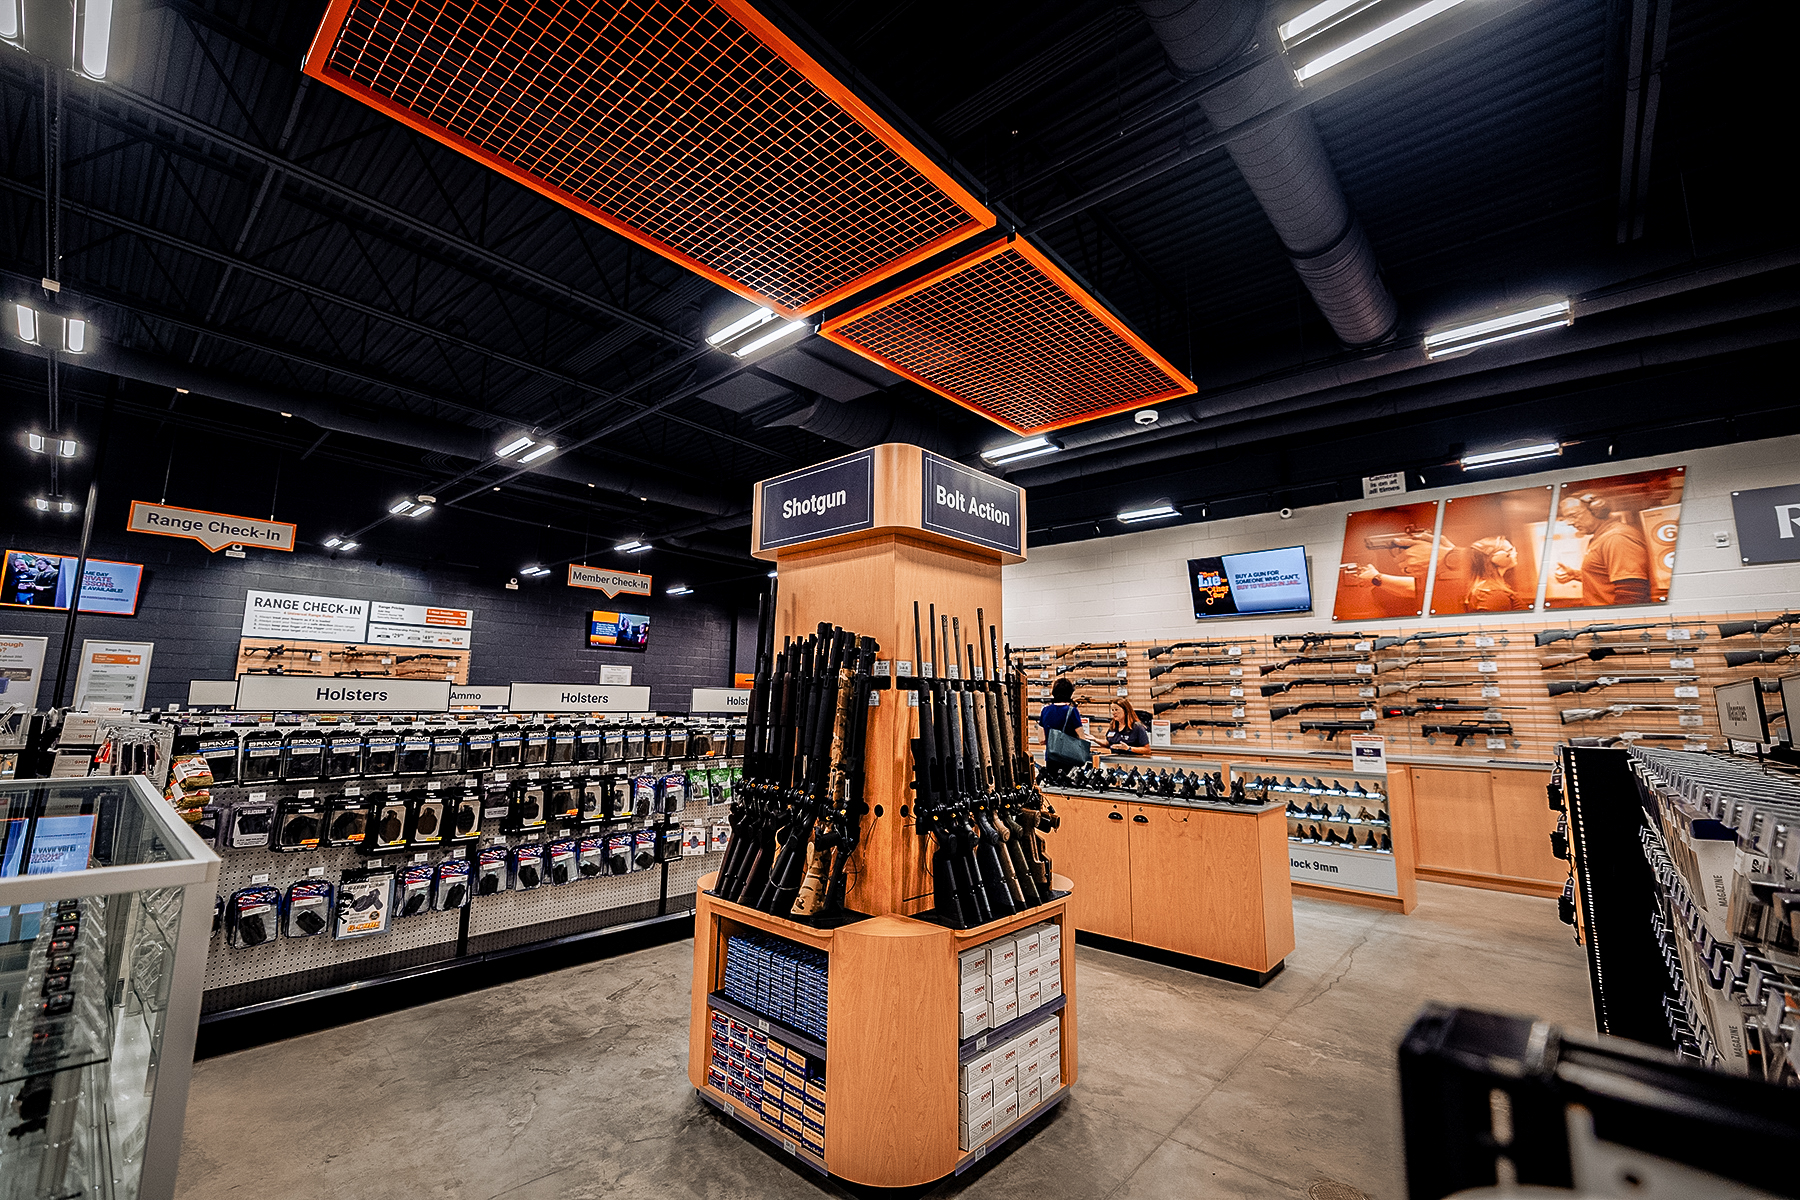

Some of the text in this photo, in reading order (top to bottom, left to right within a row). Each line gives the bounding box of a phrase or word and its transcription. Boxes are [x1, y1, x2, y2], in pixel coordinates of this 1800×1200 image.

[782, 489, 847, 519] Shotgun
[936, 484, 1010, 526] Bolt Action
[147, 513, 281, 541] Range Check-In
[573, 570, 649, 590] Member Check-In
[254, 597, 361, 615] RANGE CHECK-IN
[316, 688, 388, 701] Holsters
[561, 693, 609, 703] Holsters
[727, 696, 748, 705] Holst
[1313, 861, 1338, 873] 9mm
[1713, 875, 1728, 907] MAGAZINE
[1729, 1025, 1743, 1058] MAGAZINE
